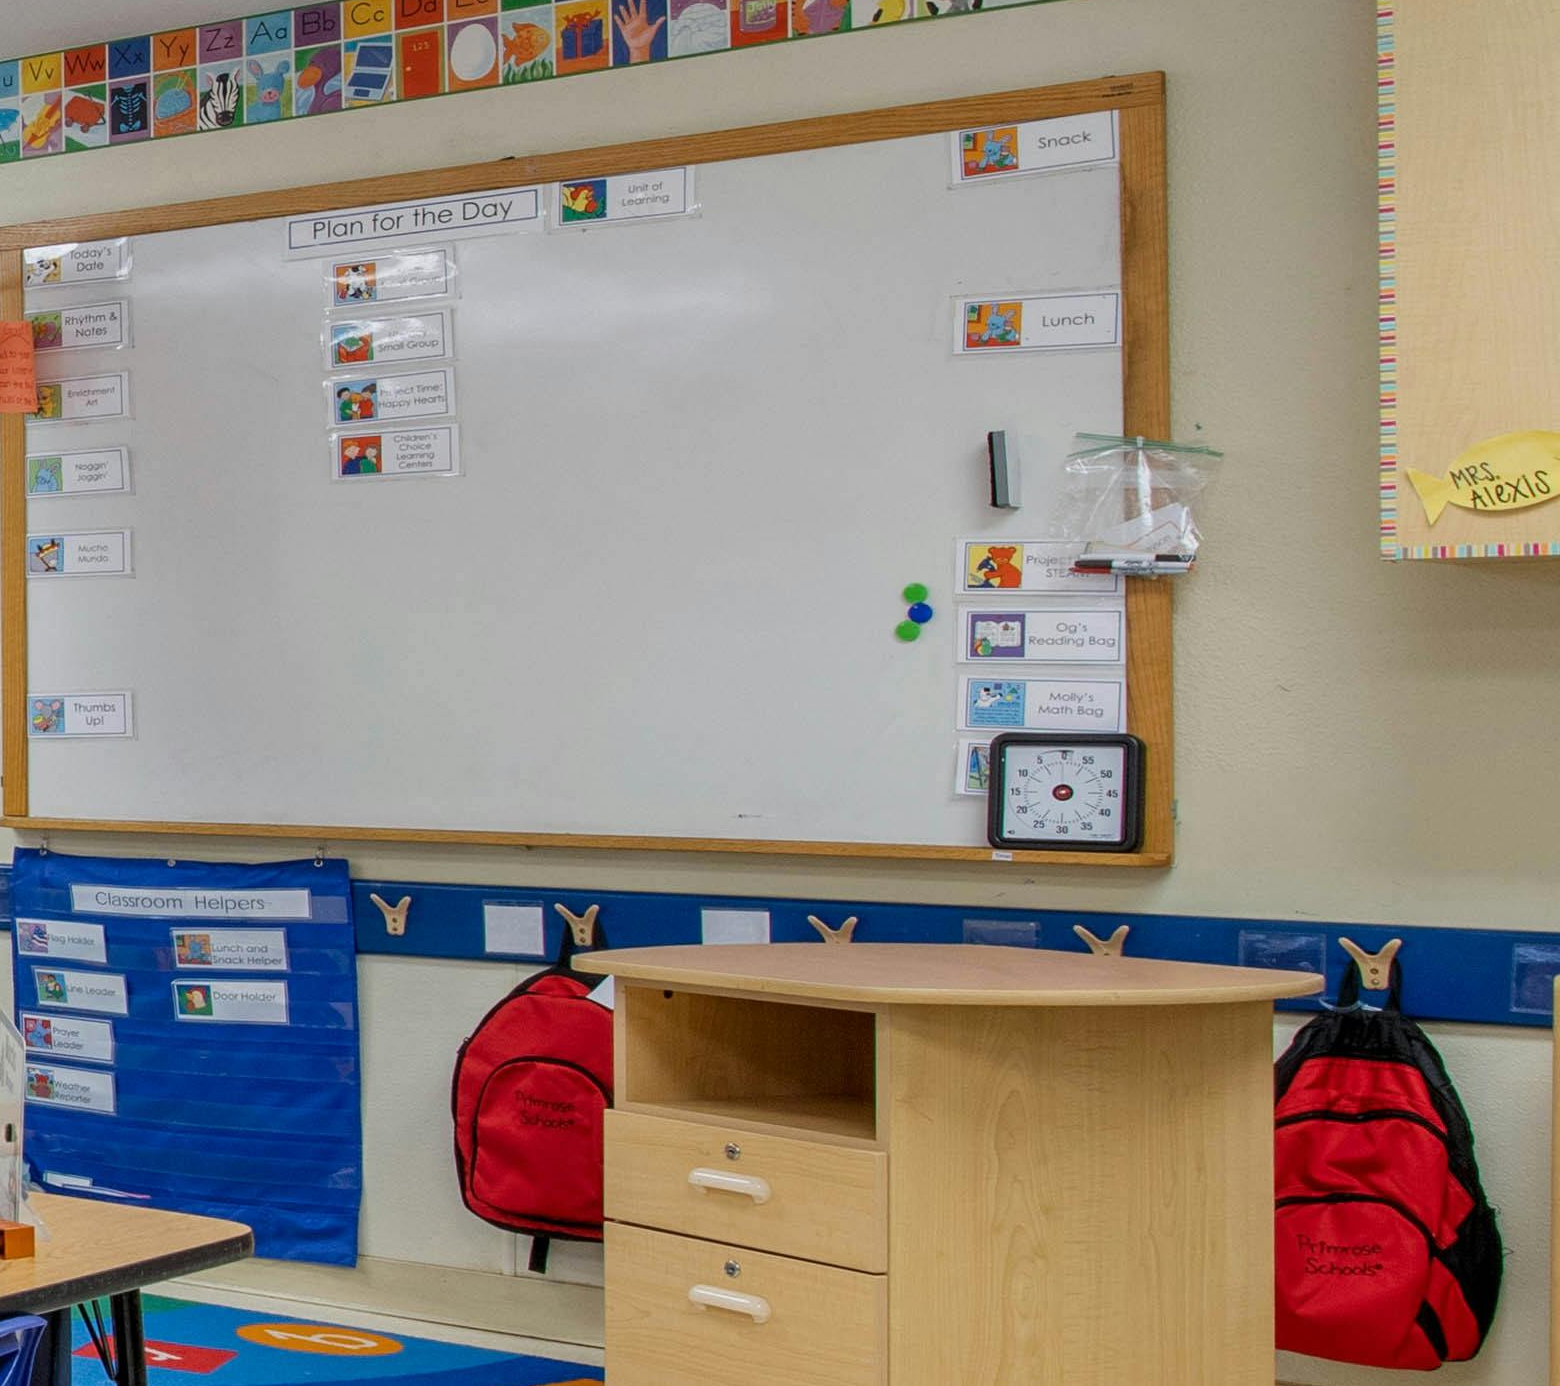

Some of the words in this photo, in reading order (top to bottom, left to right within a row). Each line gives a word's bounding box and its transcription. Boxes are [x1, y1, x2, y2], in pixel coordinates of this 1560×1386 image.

[29, 63, 54, 83] Vv
[65, 53, 106, 76] Ww
[114, 46, 144, 68] Xx
[159, 38, 190, 66] Yy
[205, 29, 235, 53] Zz
[250, 21, 288, 45] Aa
[301, 12, 335, 37] Bb
[350, 2, 385, 26] Cc
[1037, 130, 1092, 150] Snack
[628, 183, 649, 194] Unit
[652, 181, 663, 191] of
[621, 193, 670, 208] Learning
[313, 219, 364, 241] Plan
[372, 213, 404, 233] for
[412, 207, 453, 227] the
[462, 199, 514, 222] Day
[70, 246, 112, 261] Today's
[76, 261, 104, 273] Date
[64, 312, 106, 328] Rhythm
[108, 311, 117, 322] &
[1041, 313, 1095, 328] Lunch
[75, 326, 108, 339] Notes
[377, 342, 404, 354] Small
[406, 339, 439, 353] Group
[67, 386, 116, 399] Enrichment
[416, 382, 444, 393] Time:
[85, 398, 98, 408] Art
[378, 398, 411, 411] Happy
[413, 394, 447, 406] Hearts
[393, 432, 438, 443] Children's
[399, 442, 432, 452] Choice
[396, 451, 435, 462] Learning
[398, 460, 433, 470] Centers
[1449, 461, 1501, 490] MRS.
[78, 544, 109, 553] Mucho
[78, 554, 109, 563] Mundo
[1055, 621, 1088, 635] Og's
[1028, 636, 1084, 648] Reading
[1088, 636, 1116, 648] Bag
[1048, 692, 1094, 704] Molly's
[73, 702, 116, 713] Thumbs
[1038, 704, 1074, 716] Math
[1076, 705, 1104, 718] Bag
[85, 716, 105, 727] Up!
[1036, 756, 1043, 764] 5
[1081, 756, 1095, 765] 55
[1018, 769, 1028, 778] 10
[1100, 770, 1113, 779] 50
[1010, 788, 1021, 796] 15
[1105, 789, 1118, 798] 45
[1016, 805, 1028, 814] 20
[1098, 808, 1111, 817] 40
[1033, 820, 1045, 829] 25
[1055, 825, 1069, 834] 30
[1080, 821, 1093, 830] 35
[95, 891, 183, 911] Classroom
[194, 894, 265, 913] Helpers
[67, 934, 96, 947] Holder
[212, 943, 244, 954] Lunch
[246, 944, 268, 954] and
[212, 955, 245, 966] Snack
[246, 956, 283, 968] Helper
[85, 987, 116, 998] Leader
[212, 990, 239, 1002] Door
[241, 992, 276, 1002] Holder
[53, 1026, 80, 1039] Prayer
[53, 1039, 84, 1051] Leader
[54, 1080, 91, 1093] Weather
[54, 1091, 91, 1105] Reporter
[514, 1089, 575, 1113] Primrose
[1296, 1233, 1383, 1256] Primrose
